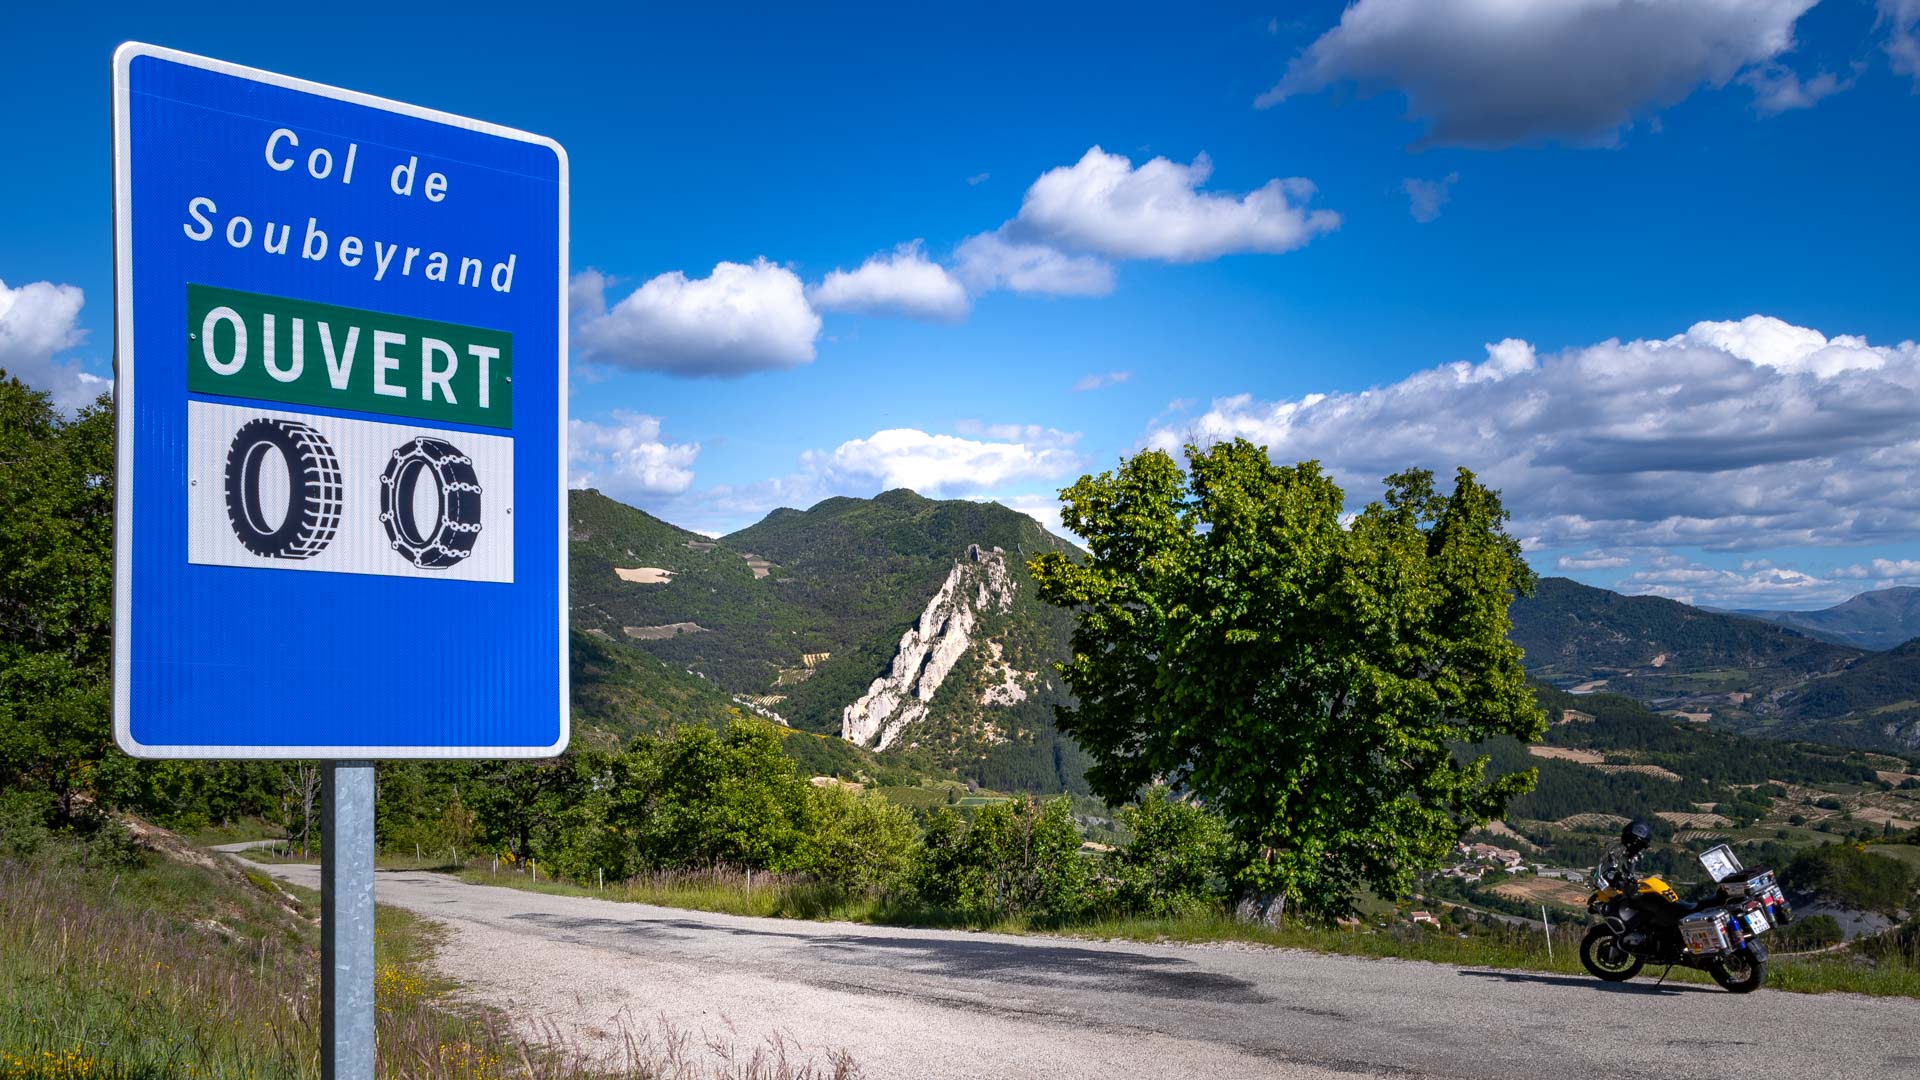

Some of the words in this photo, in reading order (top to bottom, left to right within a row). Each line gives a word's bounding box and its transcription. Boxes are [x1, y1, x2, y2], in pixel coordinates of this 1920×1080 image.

[265, 128, 358, 184] Col
[390, 156, 449, 203] de
[183, 196, 517, 294] Soubeyrand
[202, 306, 500, 409] OUVERT
